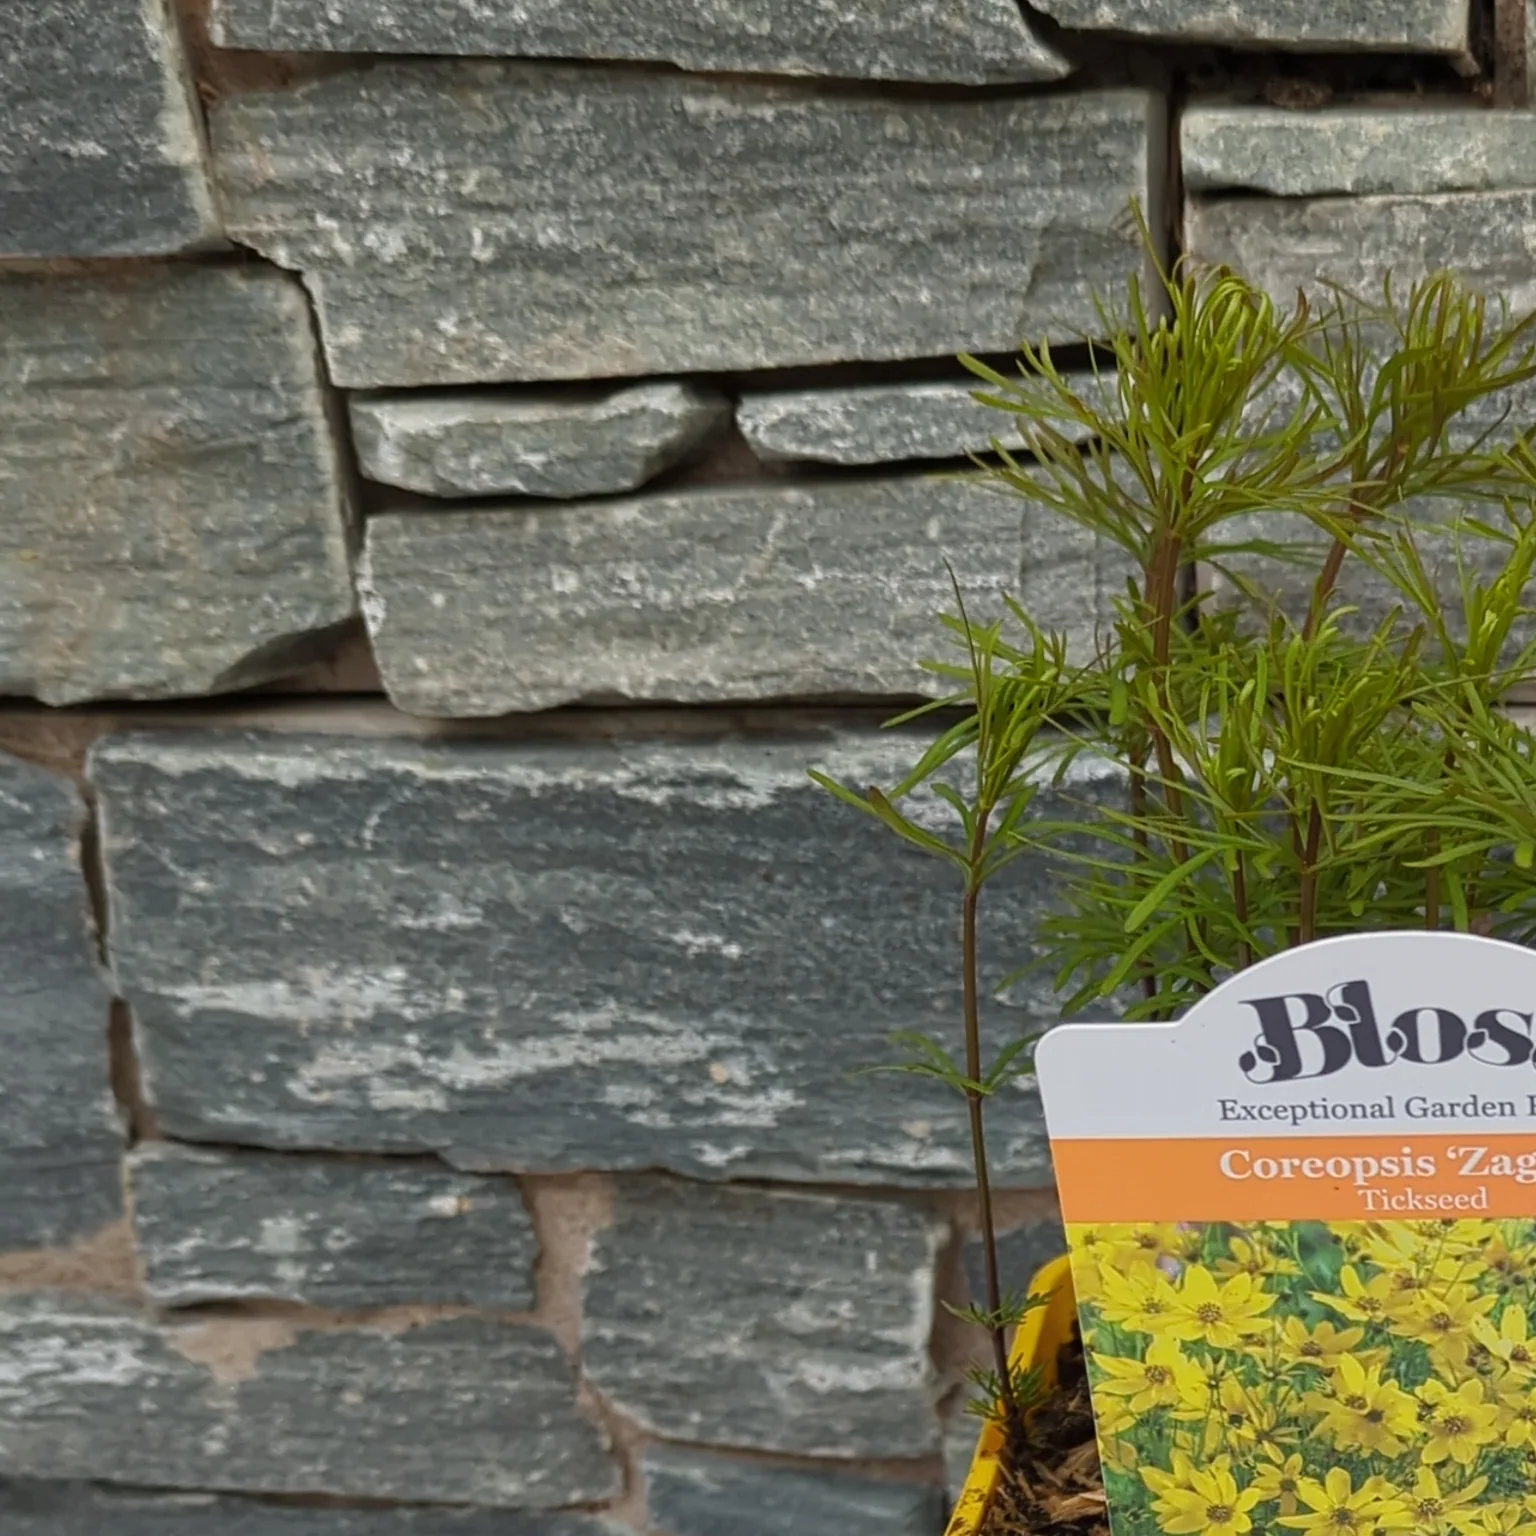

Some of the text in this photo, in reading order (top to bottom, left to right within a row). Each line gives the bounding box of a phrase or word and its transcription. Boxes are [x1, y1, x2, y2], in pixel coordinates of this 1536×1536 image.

[1217, 1095, 1396, 1126] Exceptional
[1404, 1094, 1517, 1119] Garden
[1219, 1145, 1437, 1187] Coreopsis
[1357, 1185, 1489, 1211] Tickseed
